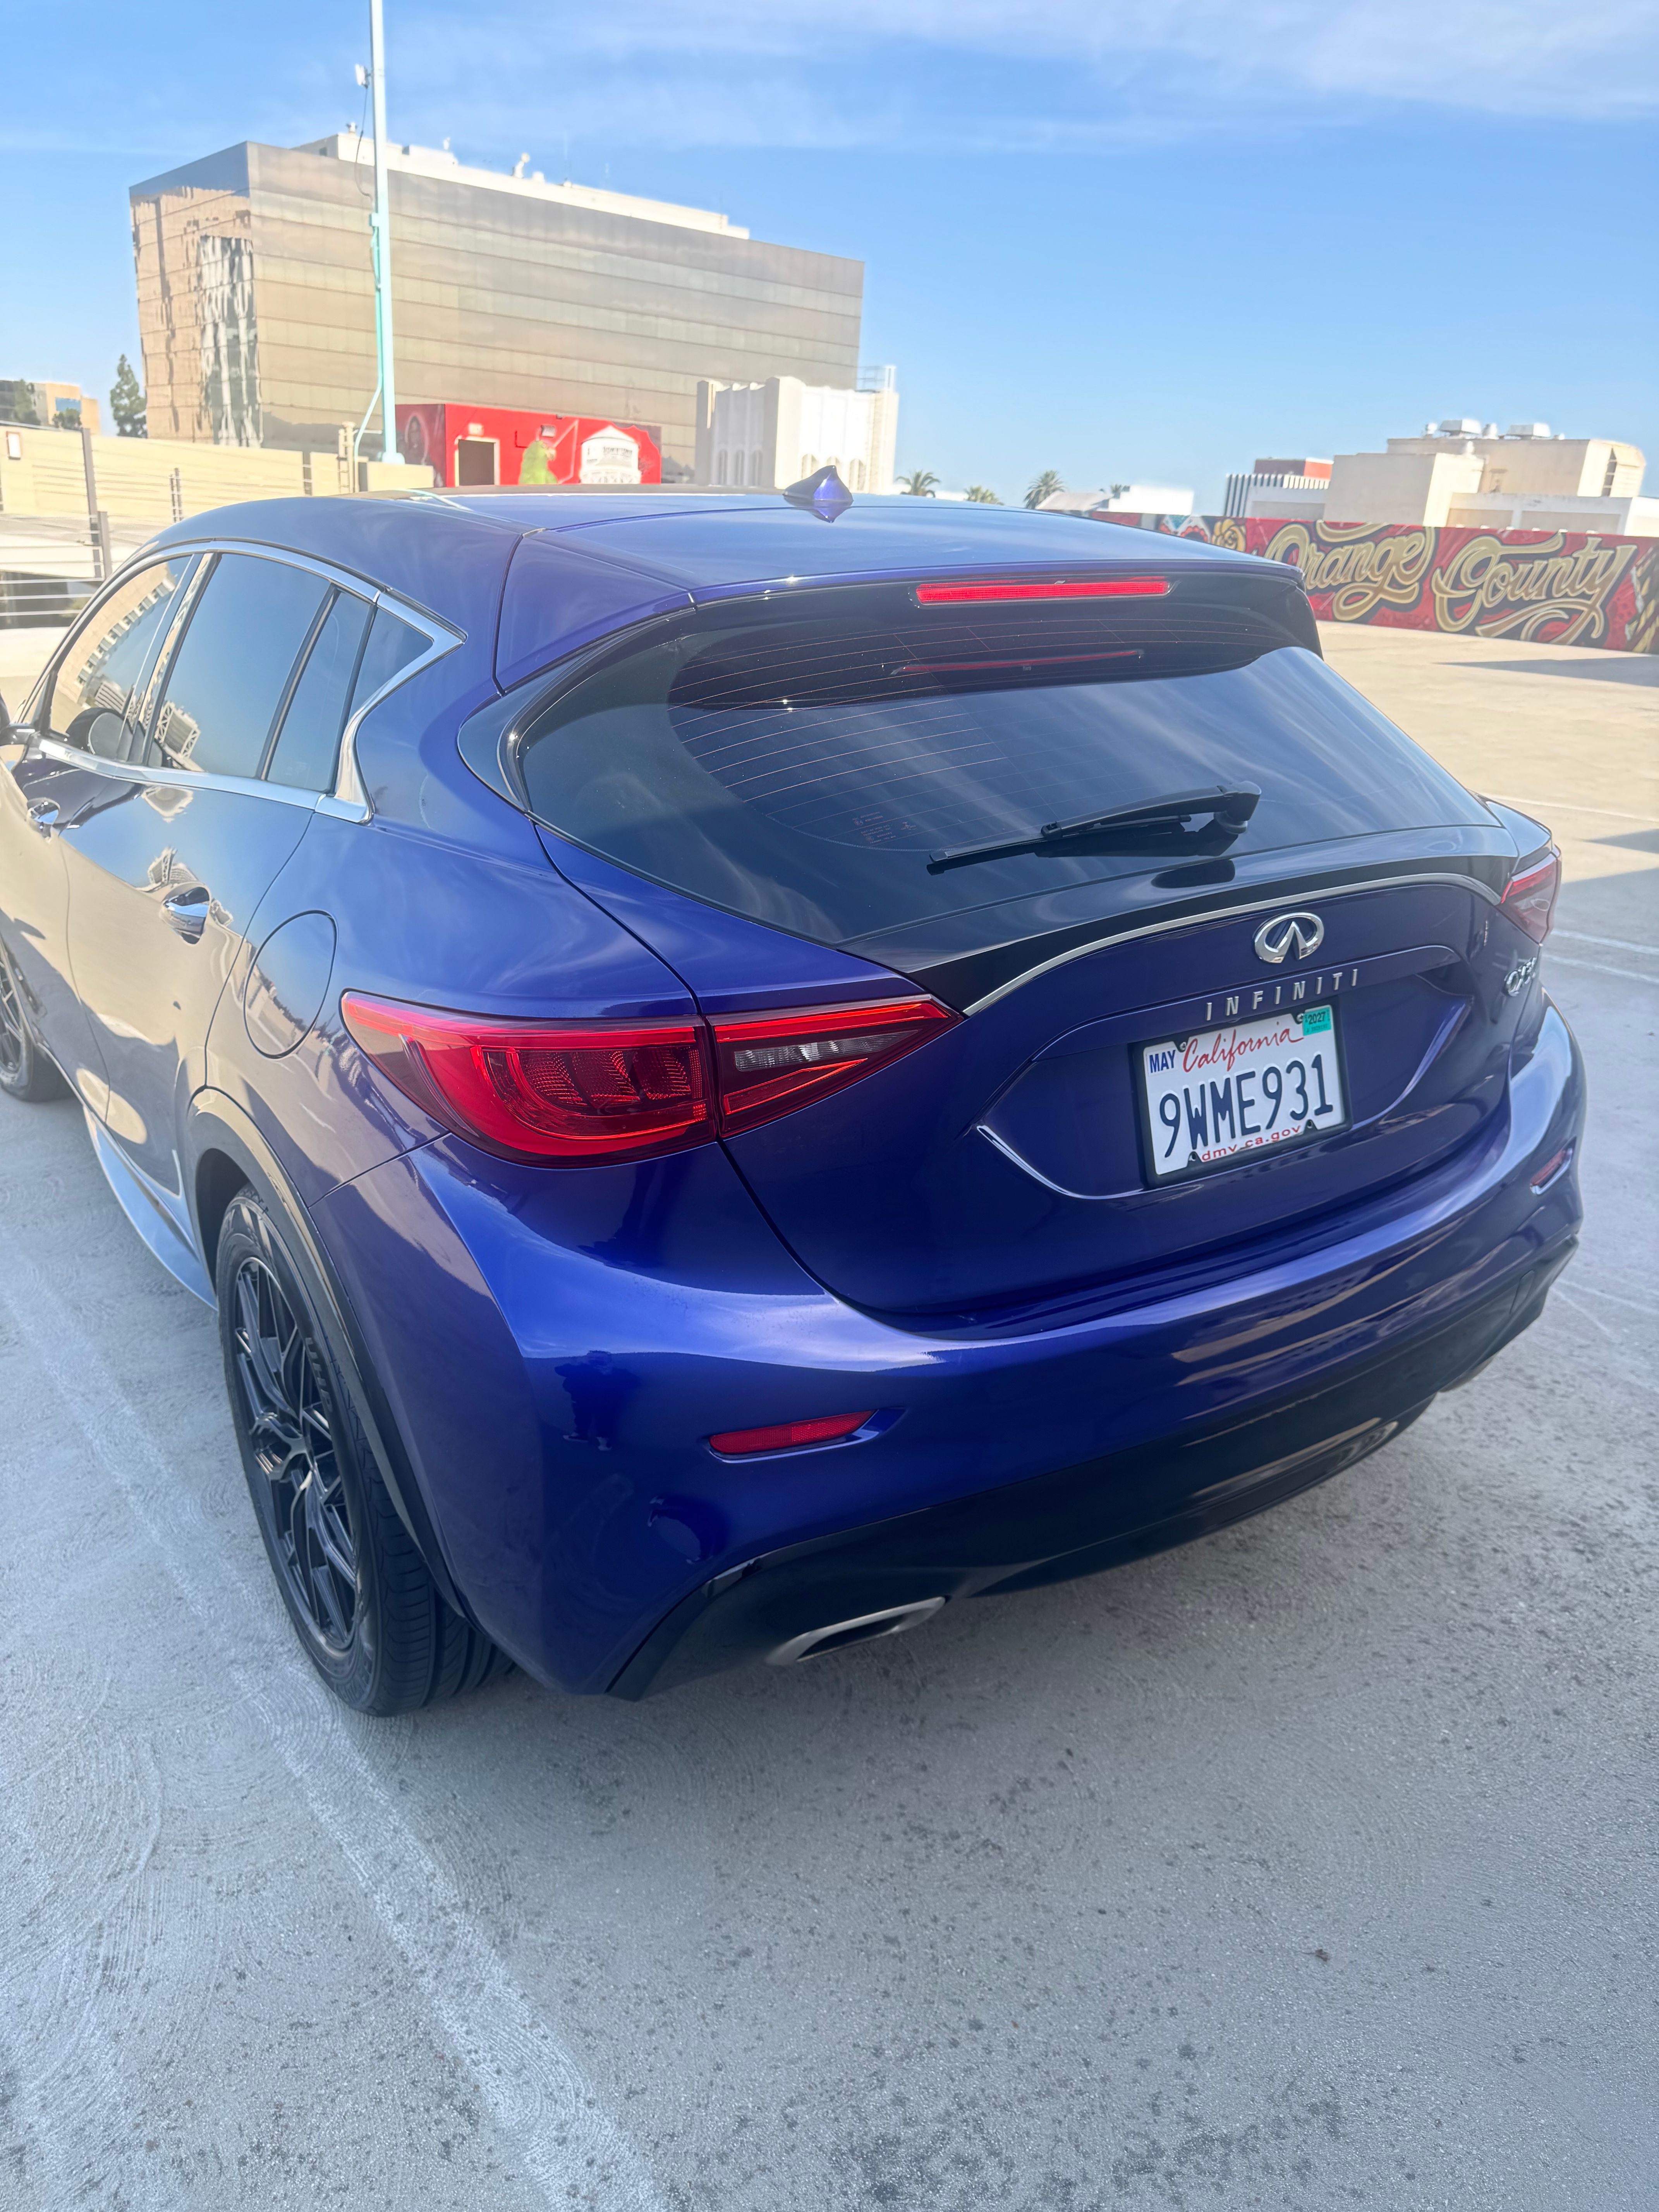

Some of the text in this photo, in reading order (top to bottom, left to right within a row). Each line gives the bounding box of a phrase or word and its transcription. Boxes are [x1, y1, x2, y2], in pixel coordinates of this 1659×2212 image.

[1264, 520, 1637, 644] Orange County
[1206, 969, 1358, 1021] INFINITI
[1308, 1011, 1326, 1024] 2027
[1149, 1049, 1176, 1073] MAY
[1183, 1022, 1304, 1072] California
[1159, 1054, 1333, 1158] 9WME931
[1202, 1125, 1300, 1161] dmvca.gov
